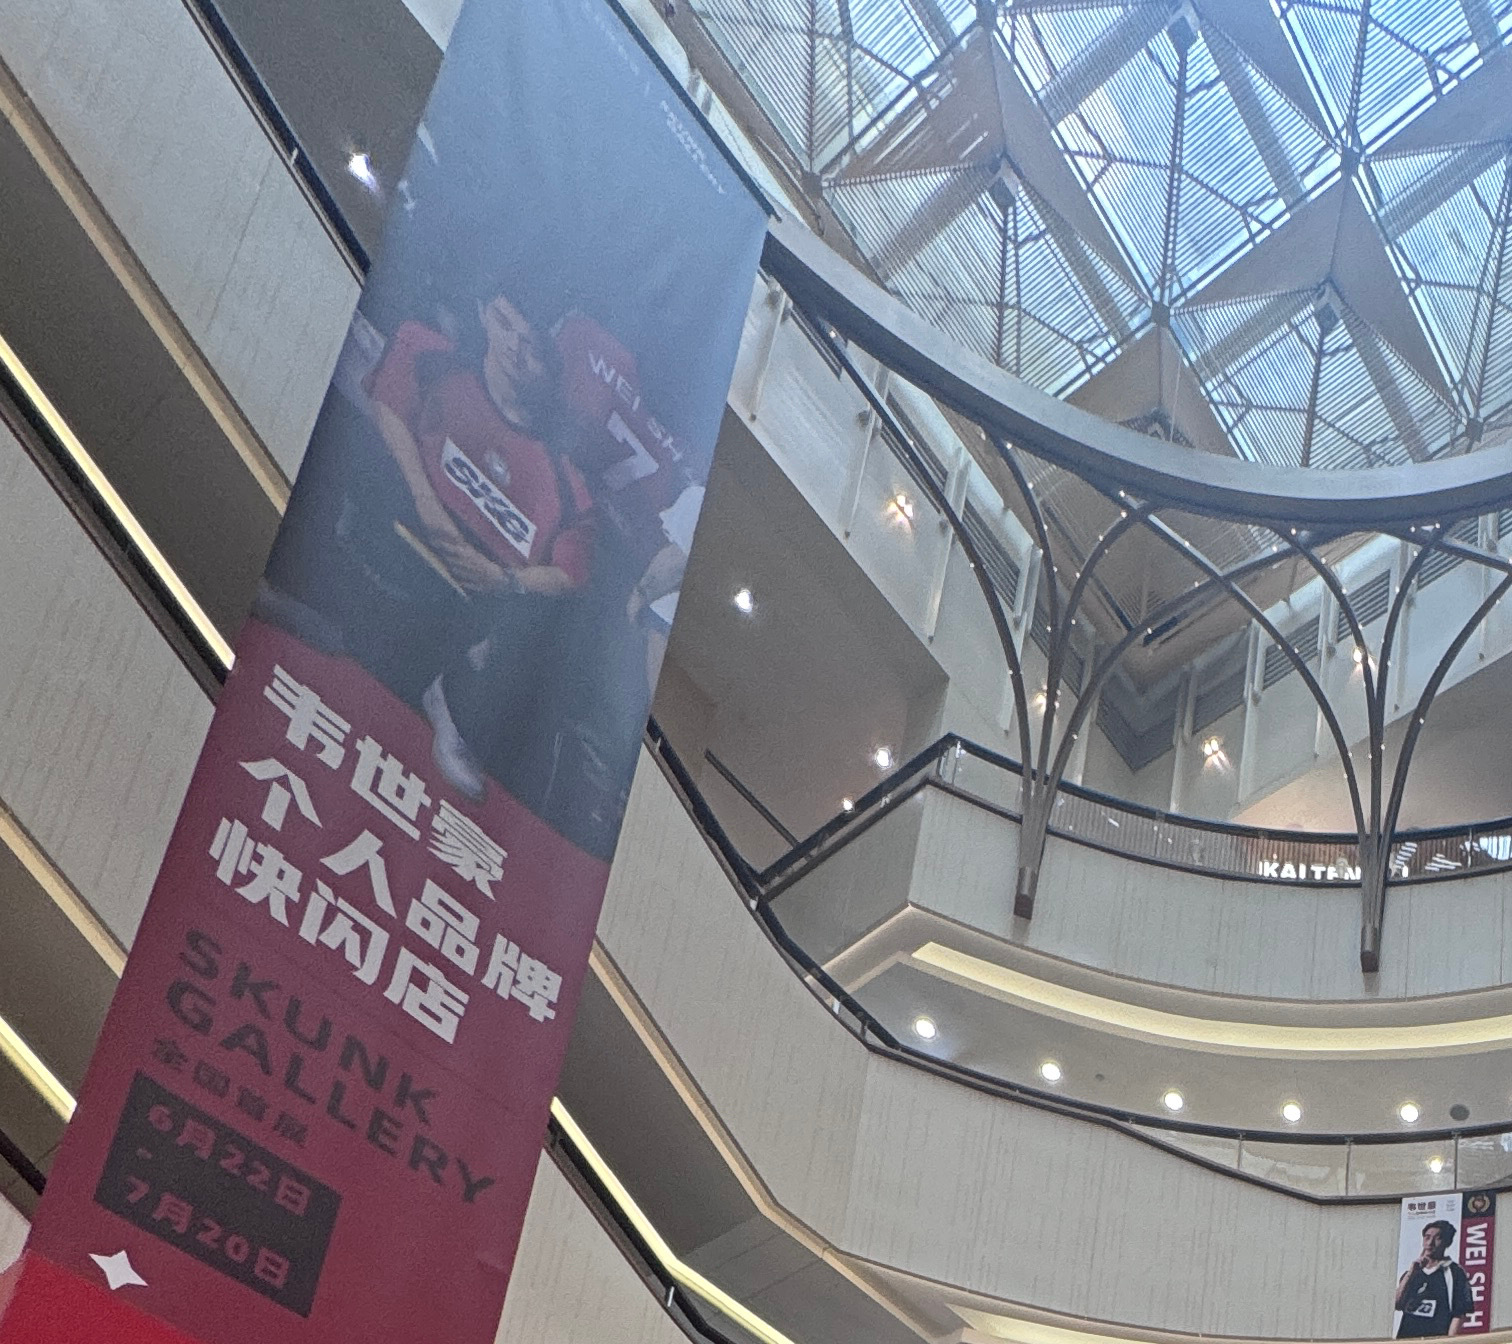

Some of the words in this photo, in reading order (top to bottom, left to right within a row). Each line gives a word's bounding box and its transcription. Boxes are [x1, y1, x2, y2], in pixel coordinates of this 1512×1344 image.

[607, 410, 659, 490] 7
[263, 663, 508, 901] 韦世豪
[208, 817, 470, 1045] 快闪店
[238, 757, 563, 1023] 个人品牌
[166, 979, 496, 1203] GALLERY
[179, 928, 436, 1126] SKUNK
[124, 1176, 290, 1289] 7月20日
[147, 1103, 311, 1216] 6月22日
[1465, 1223, 1487, 1266] WEI
